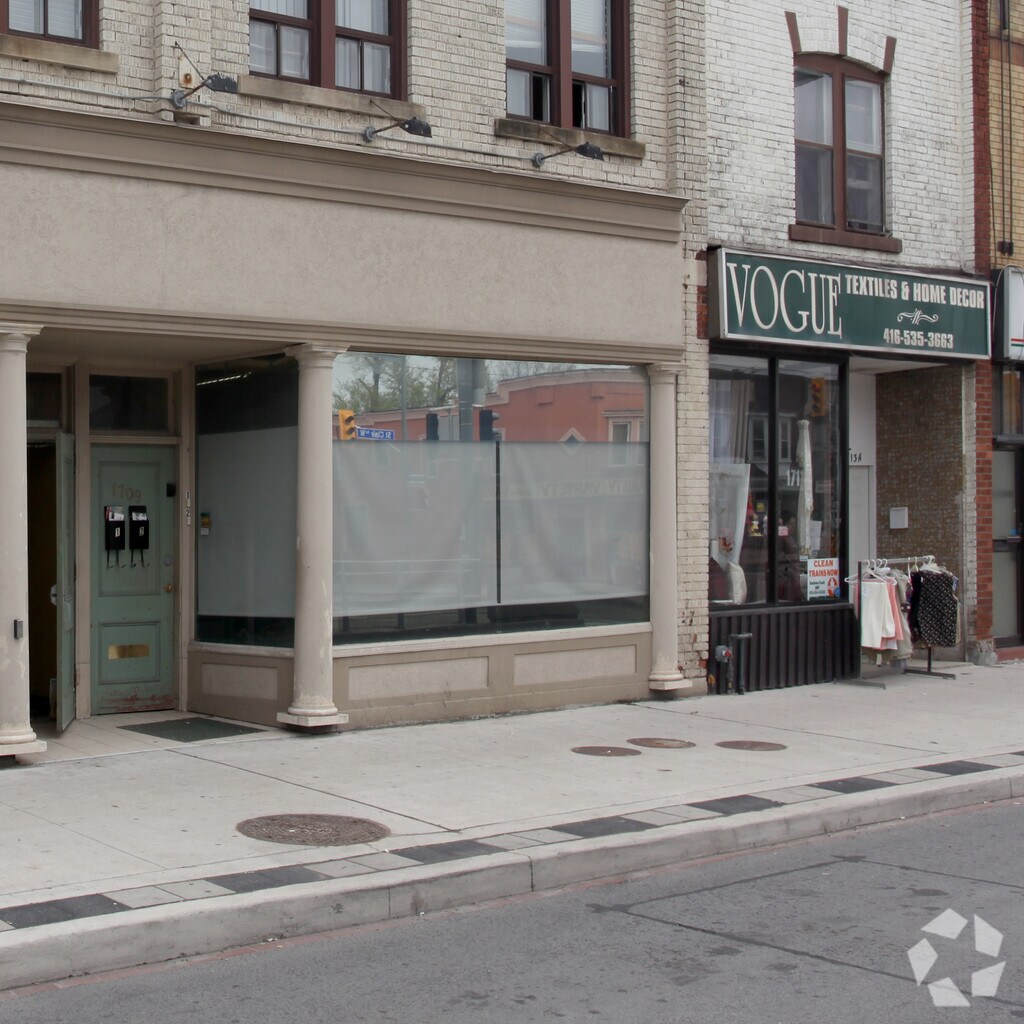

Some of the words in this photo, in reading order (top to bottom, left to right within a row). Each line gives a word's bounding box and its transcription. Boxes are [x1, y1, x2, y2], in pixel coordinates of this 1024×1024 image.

[726, 262, 843, 340] VOGUE
[845, 274, 897, 299] TEXTILES
[901, 281, 910, 300] &
[913, 282, 946, 305] HOME
[949, 287, 985, 309] DECOR
[883, 327, 954, 349] 416-535-3663
[809, 569, 826, 577] TRAINS
